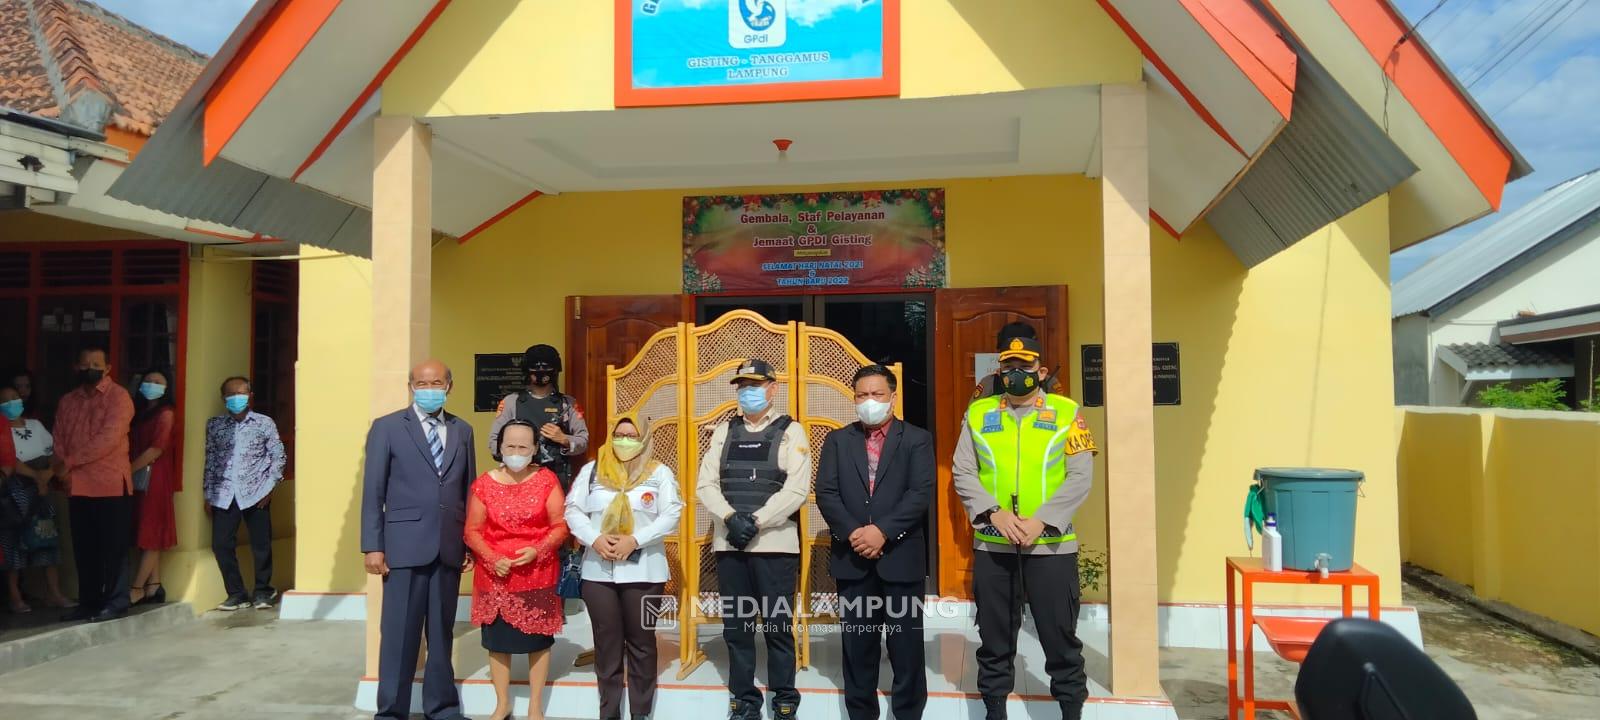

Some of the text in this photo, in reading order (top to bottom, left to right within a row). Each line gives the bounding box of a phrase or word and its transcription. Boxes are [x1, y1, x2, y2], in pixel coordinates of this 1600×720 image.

[688, 57, 739, 68] GISTING
[750, 52, 829, 65] TANGGAMUS
[728, 67, 788, 79] LAMPUNG
[740, 210, 885, 224] Gembala, Staf Pelayanan
[807, 224, 817, 234] &
[753, 234, 872, 248] Jemaat GPDI Gisting
[761, 262, 796, 271] SELAMAT
[818, 260, 842, 270] NATAL
[776, 276, 849, 286] TAHUN BARU 2022
